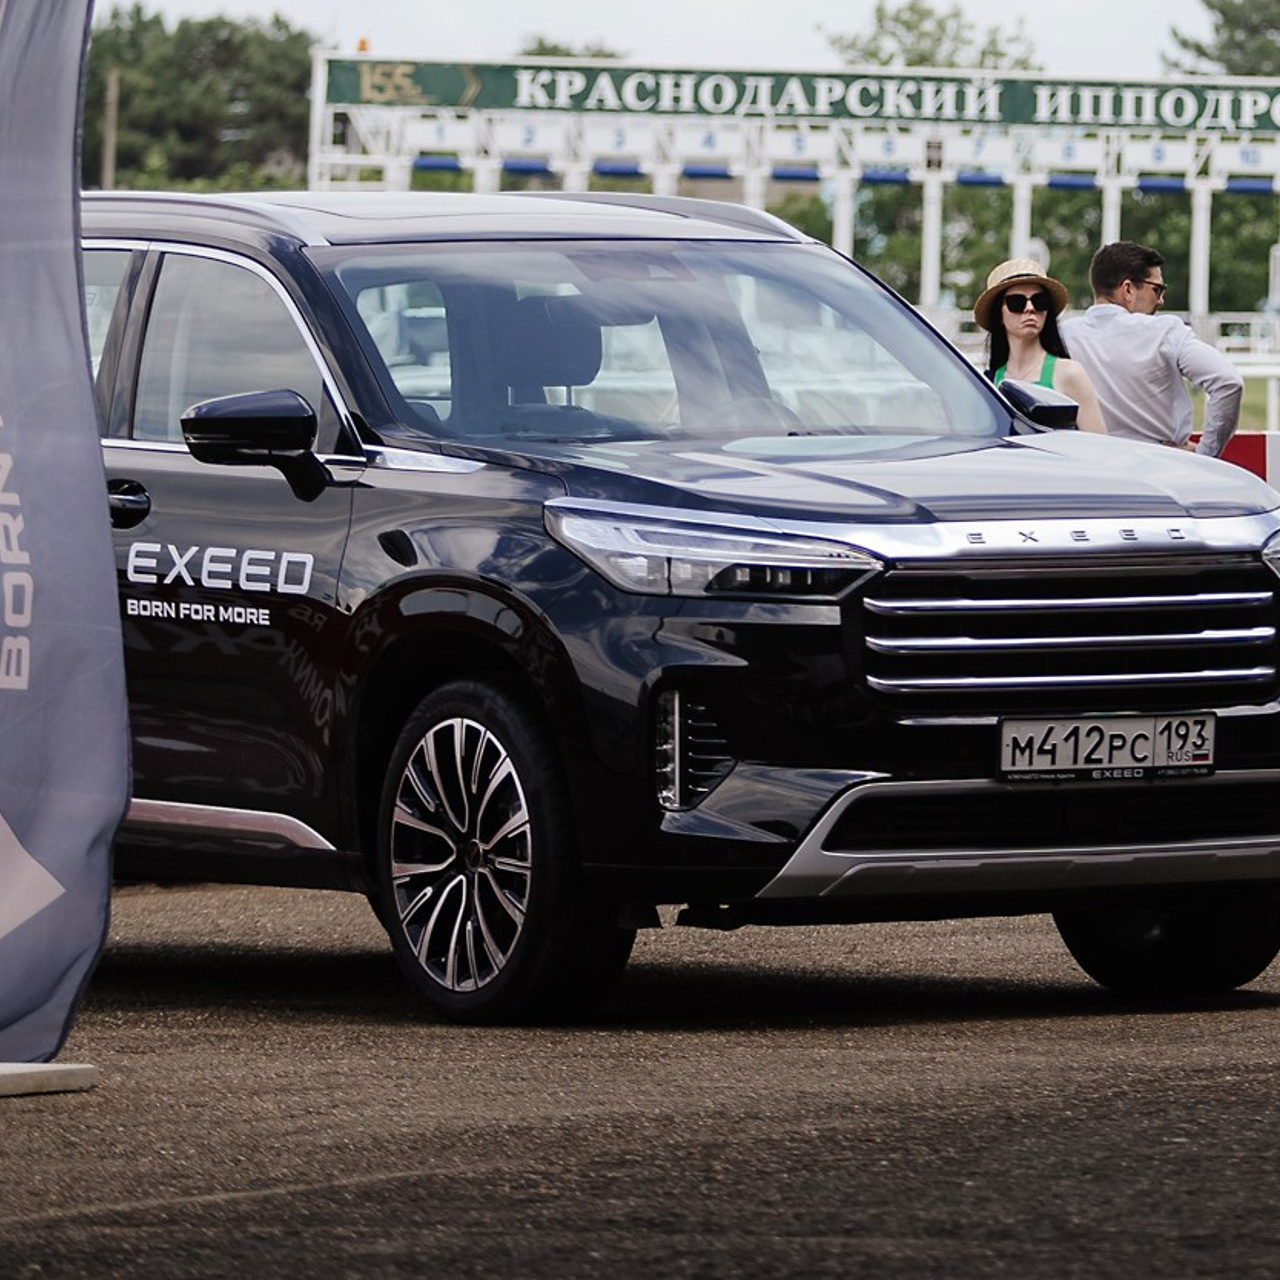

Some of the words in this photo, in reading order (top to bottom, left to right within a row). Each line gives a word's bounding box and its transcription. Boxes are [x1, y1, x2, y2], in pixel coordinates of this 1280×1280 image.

[514, 69, 1003, 120] КРАСНОДАРСКИЙ
[966, 528, 1186, 545] EXEED
[127, 542, 314, 595] EXEED
[127, 599, 176, 618] BORN
[180, 602, 215, 621] FOR
[219, 606, 270, 626] MORE
[1158, 719, 1207, 751] 193
[1168, 750, 1192, 763] RUS
[1092, 769, 1144, 779] EXEED
